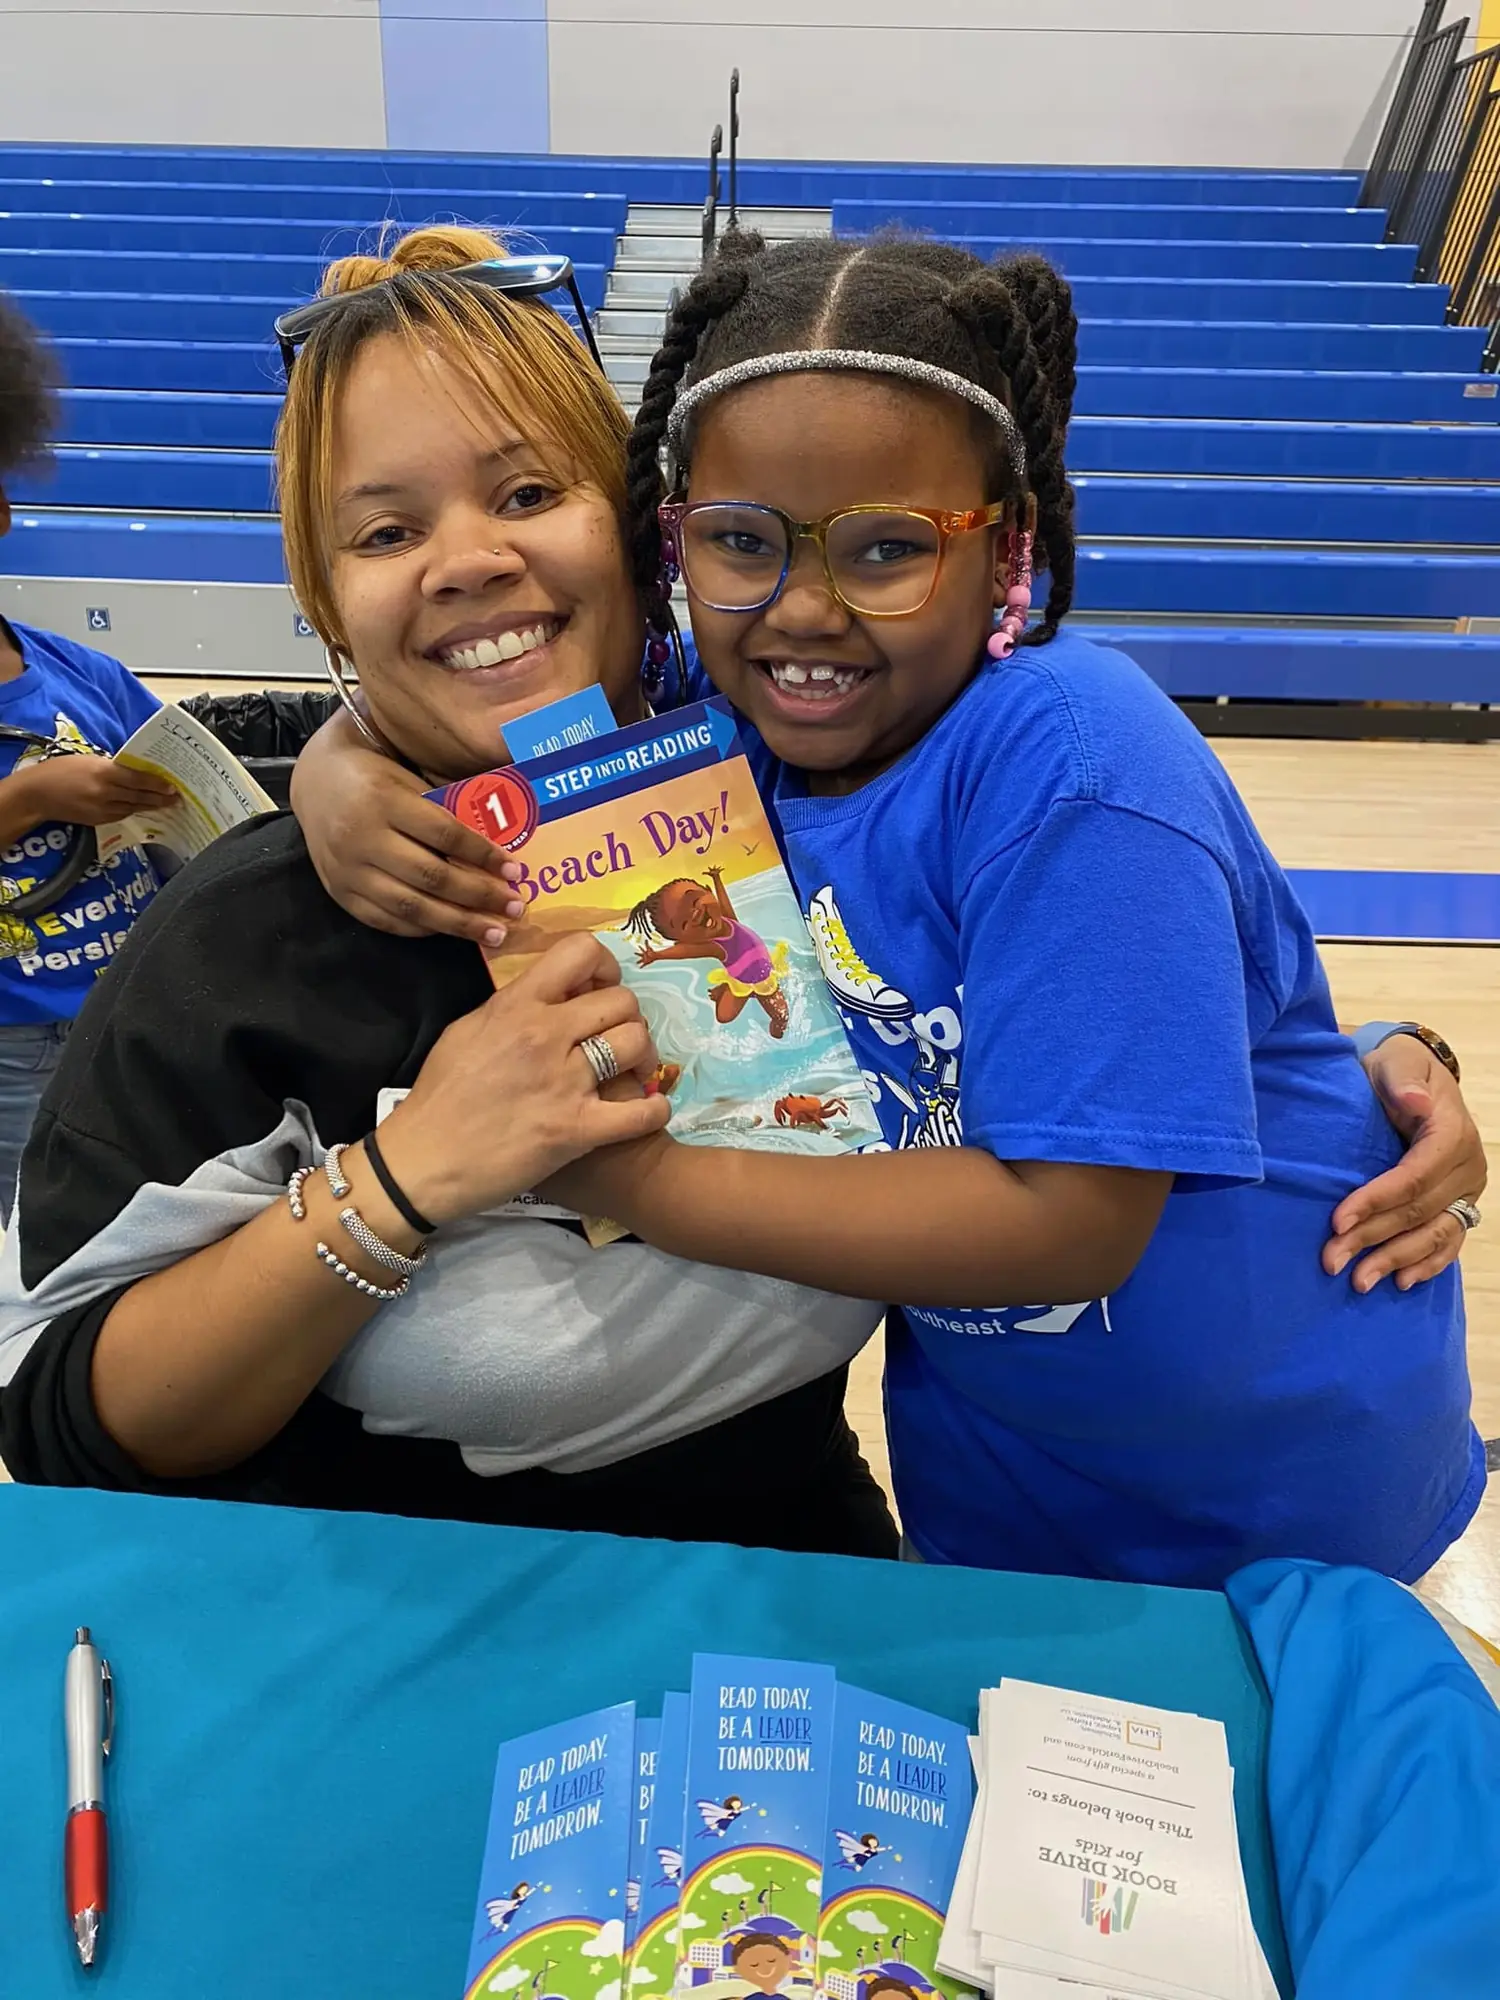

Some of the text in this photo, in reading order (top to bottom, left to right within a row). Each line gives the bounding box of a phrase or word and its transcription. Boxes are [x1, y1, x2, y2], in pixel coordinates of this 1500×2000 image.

[545, 766, 593, 797] STEP
[595, 758, 626, 779] INTO
[485, 792, 508, 831] 1
[508, 791, 729, 904] Beach Day!
[720, 1686, 812, 1710] READ TODAY.
[719, 1716, 812, 1741] BE A LEADER
[859, 1720, 948, 1766] READ TODAY.
[1131, 1725, 1162, 1739] SLHA
[519, 1734, 608, 1792] READ TODAY.
[717, 1746, 815, 1772] TOMORROW.
[858, 1751, 947, 1797] BE A LEADER
[1043, 1735, 1180, 1774] BookDriveForKids.com and
[1066, 1755, 1092, 1767] from
[1093, 1759, 1110, 1771] gift
[1111, 1765, 1145, 1778] special
[513, 1768, 605, 1827] BE A LEADER
[856, 1780, 949, 1829] TOMORROW.
[1027, 1787, 1193, 1840] This book belongs to:
[511, 1799, 603, 1860] TOMORROW.
[1038, 1846, 1178, 1896] BOOK DRIVE
[1075, 1838, 1144, 1866] for Kids
